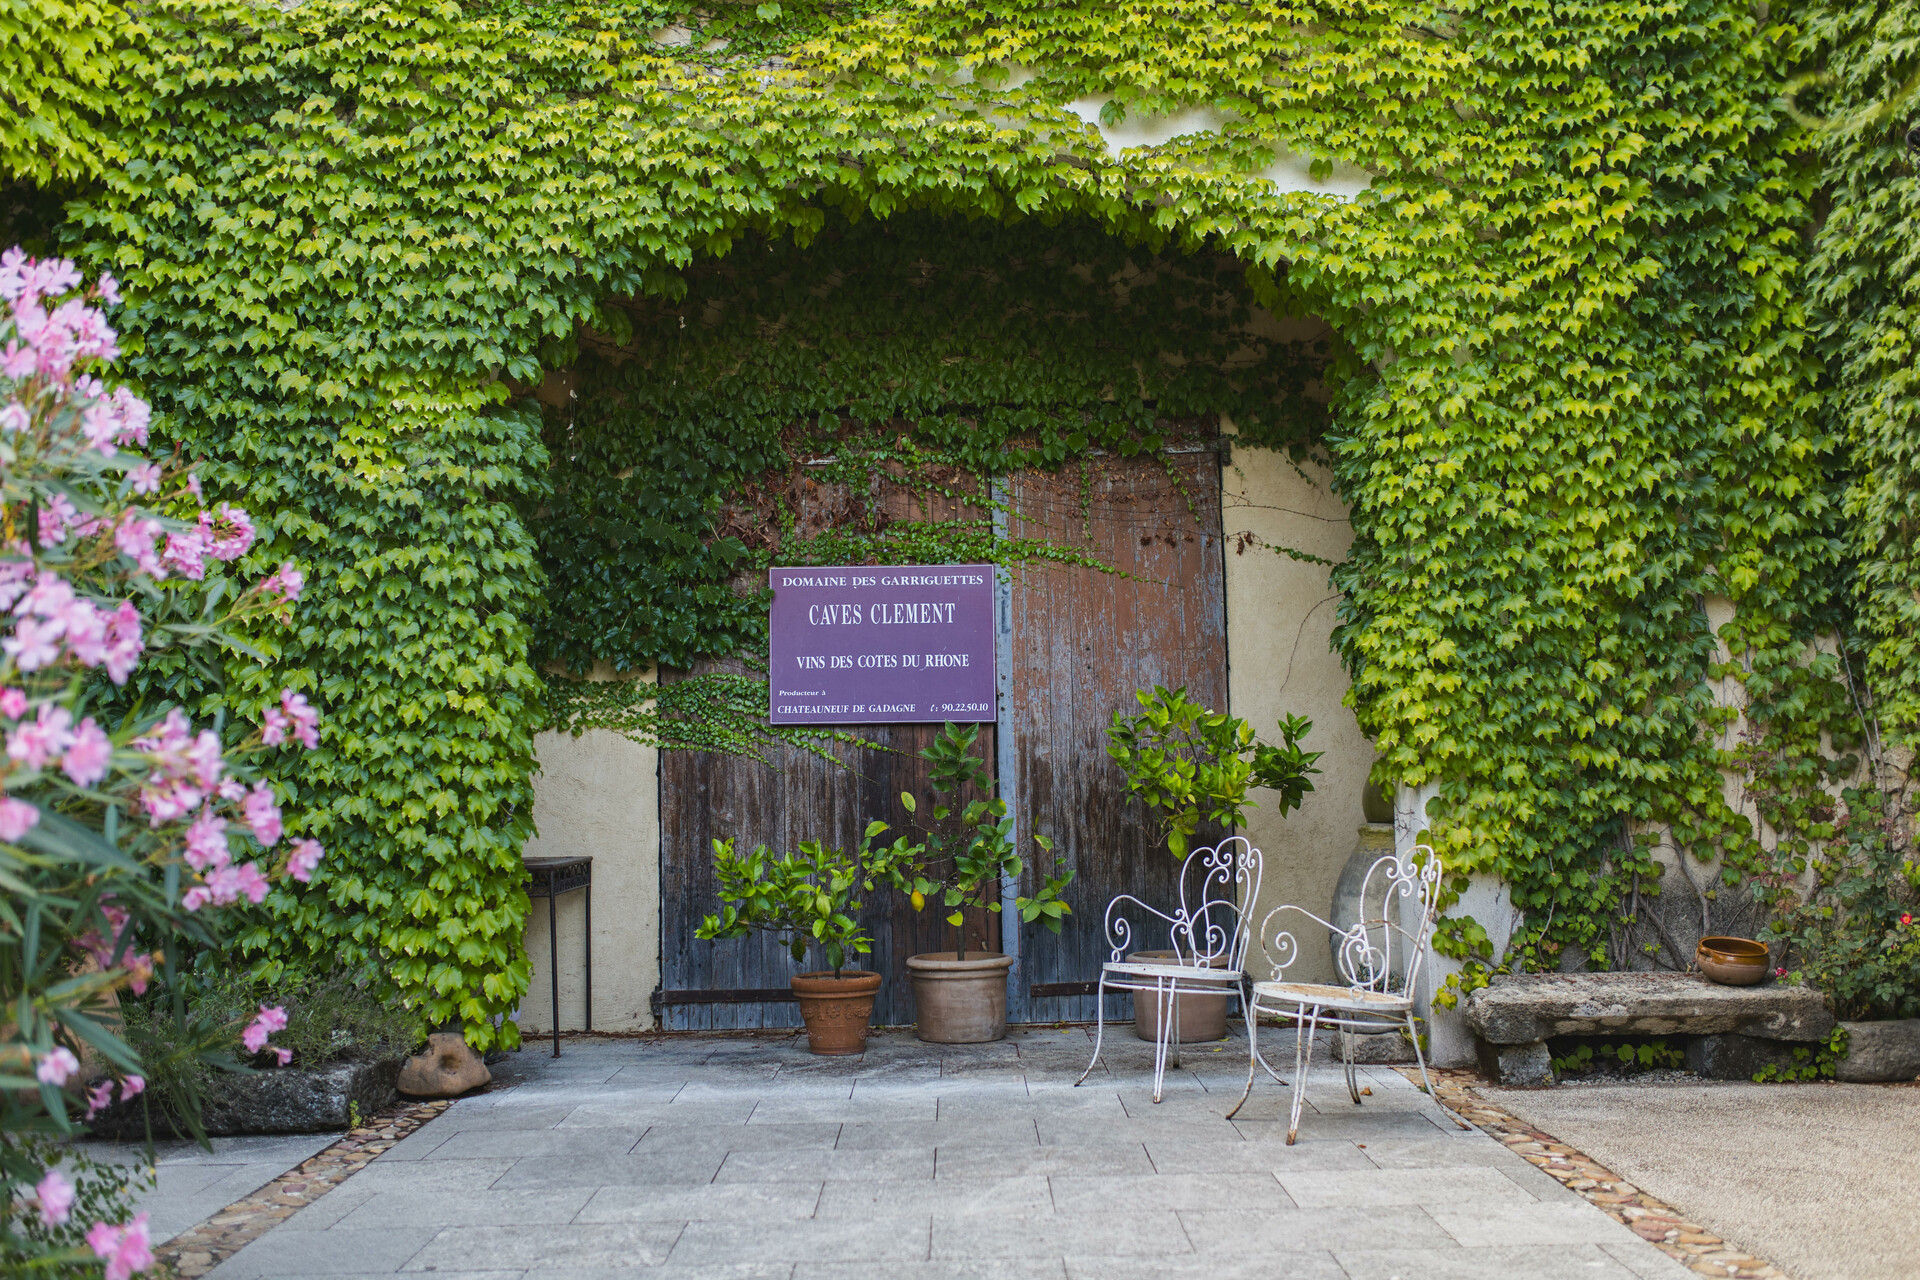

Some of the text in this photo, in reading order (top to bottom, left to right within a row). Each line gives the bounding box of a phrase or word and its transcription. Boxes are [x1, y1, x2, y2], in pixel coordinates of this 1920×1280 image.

[783, 575, 984, 587] DOMAINE DES GARRIGUETTES
[809, 603, 956, 625] CAVES CLEMENT
[796, 654, 969, 669] VINS DES COTES DU RHONE
[777, 705, 849, 714] CHATEAUNEUF
[853, 705, 865, 713] DE
[869, 704, 916, 713] GADAGNE
[941, 703, 988, 712] 90.22.50.10
